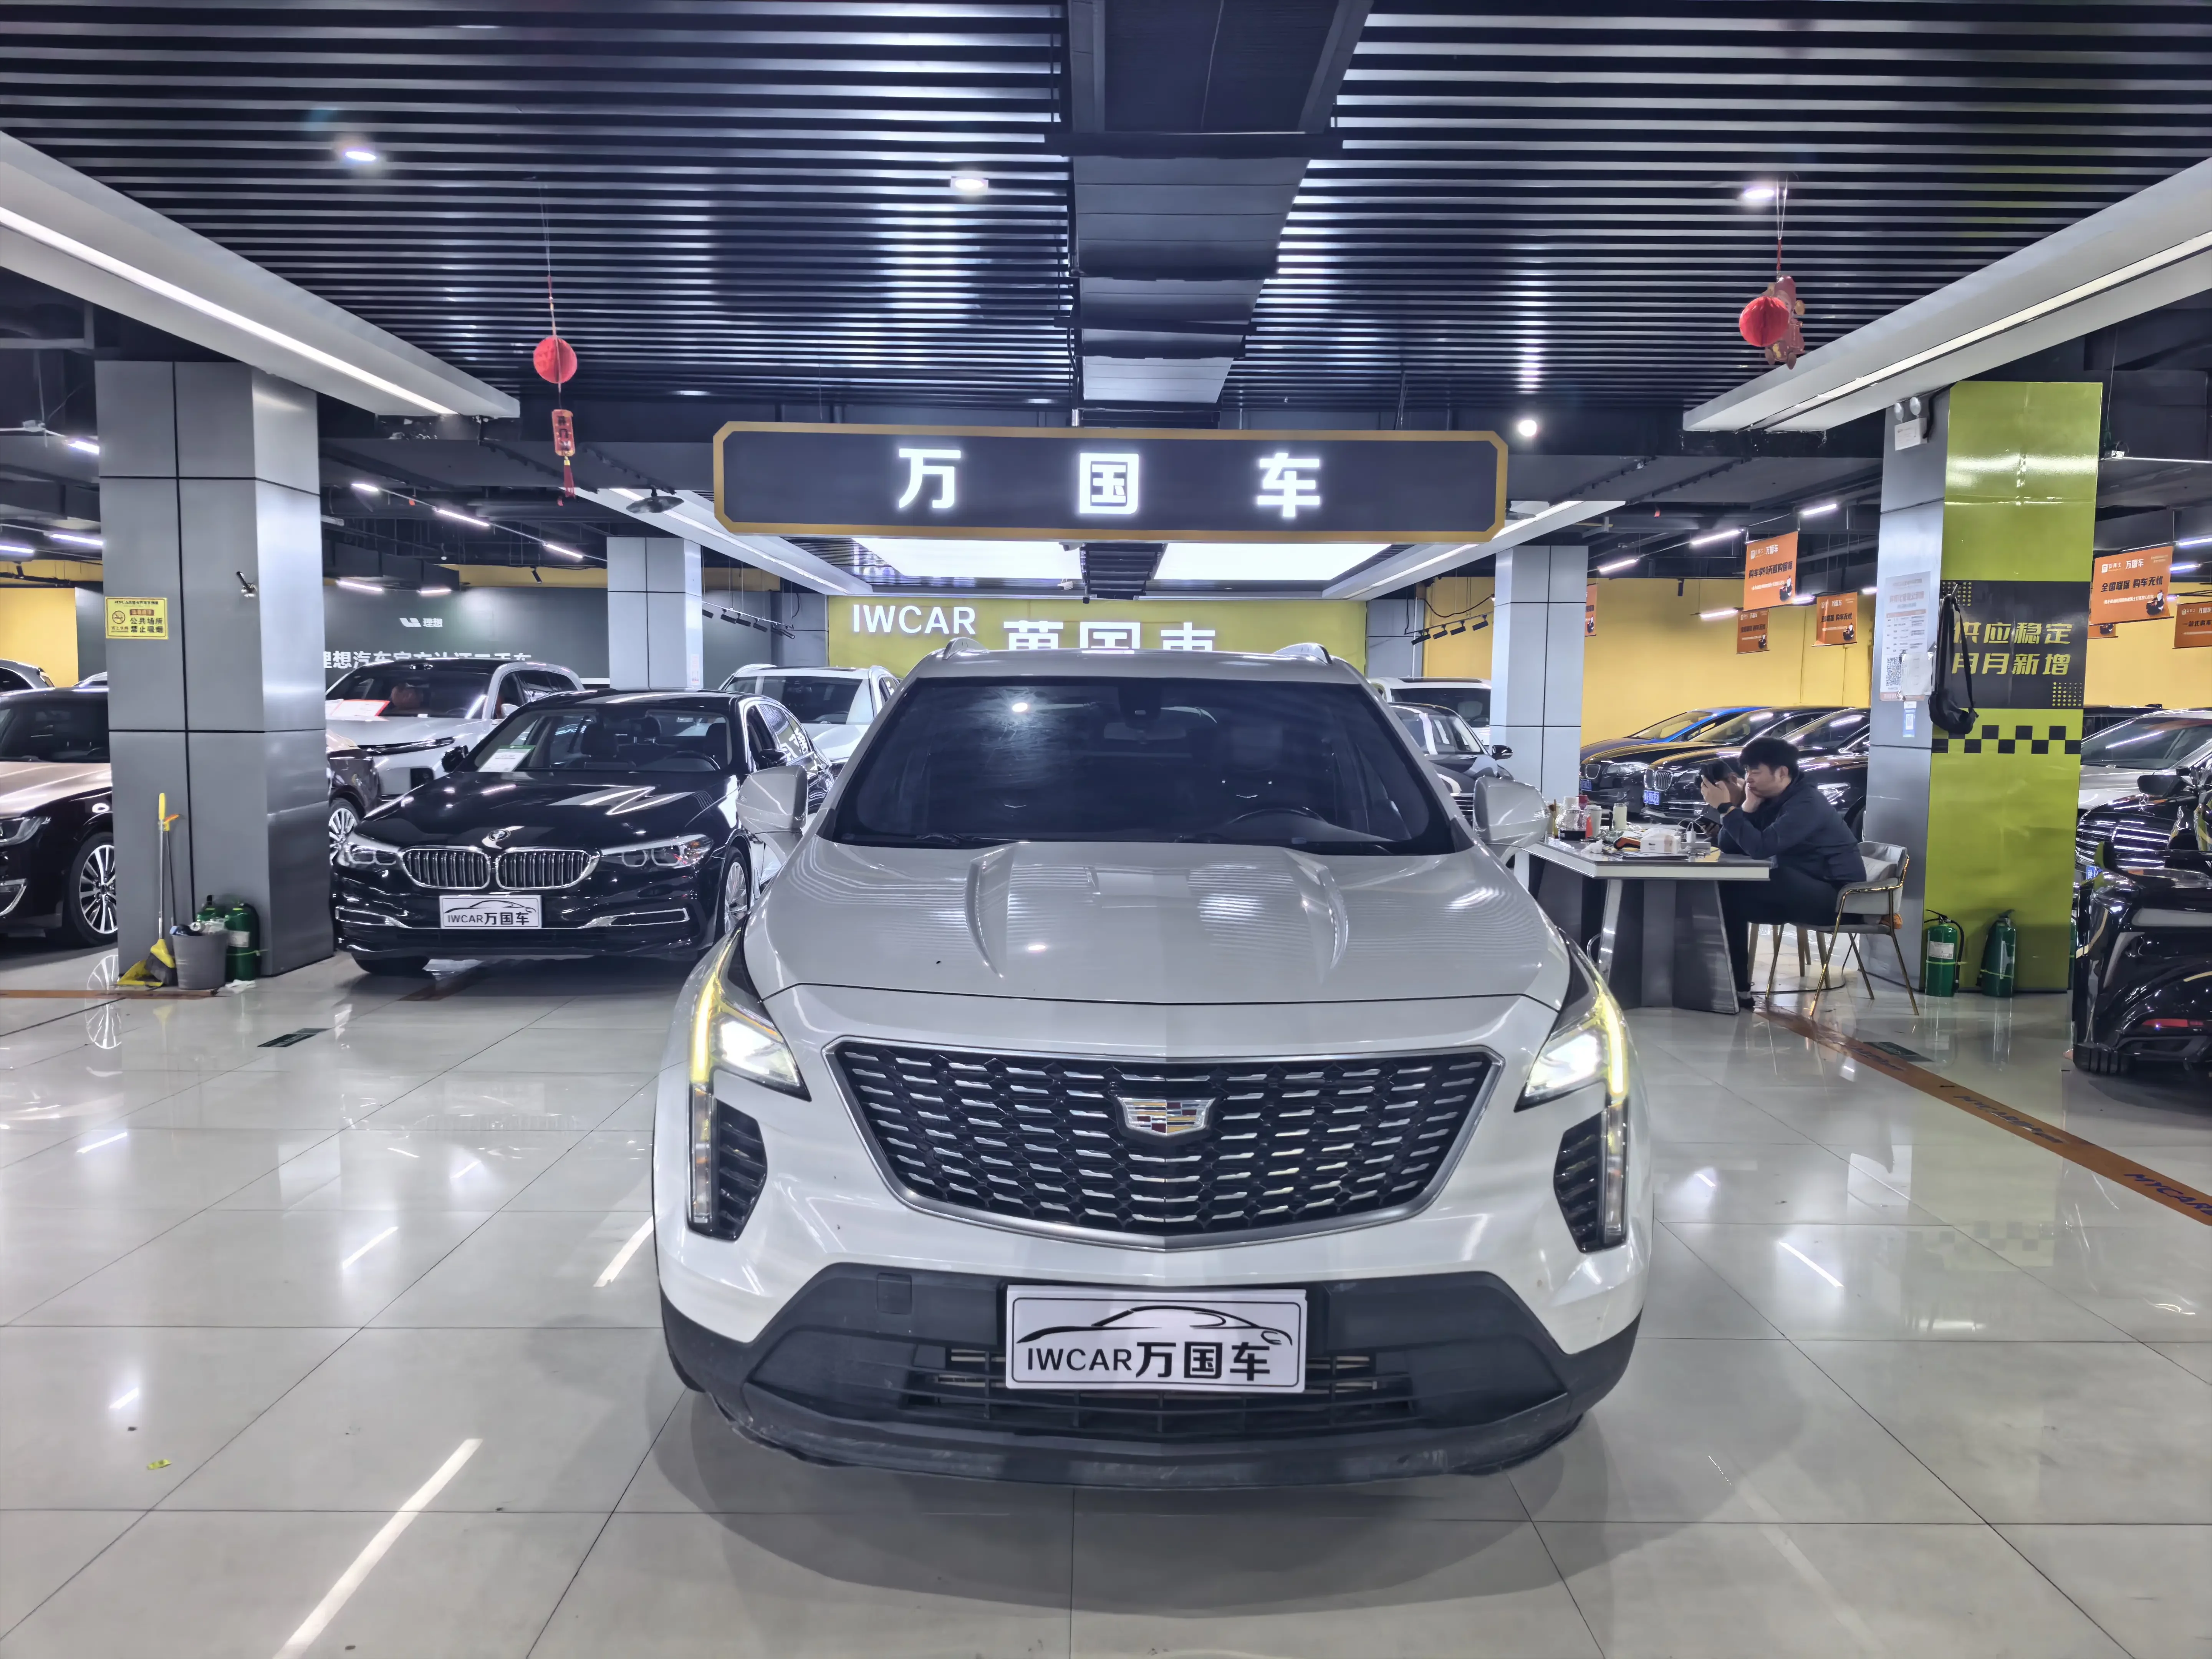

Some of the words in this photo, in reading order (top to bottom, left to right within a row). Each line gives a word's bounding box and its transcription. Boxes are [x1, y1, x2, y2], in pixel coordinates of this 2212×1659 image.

[898, 448, 1321, 517] 万国车
[2126, 559, 2144, 570] 万国车
[2133, 576, 2163, 588] 购车无忧
[423, 618, 443, 628] 理想
[853, 604, 976, 634] IWCAR
[1954, 621, 2073, 644] 供应稳定
[1952, 652, 2071, 675] 月月新增
